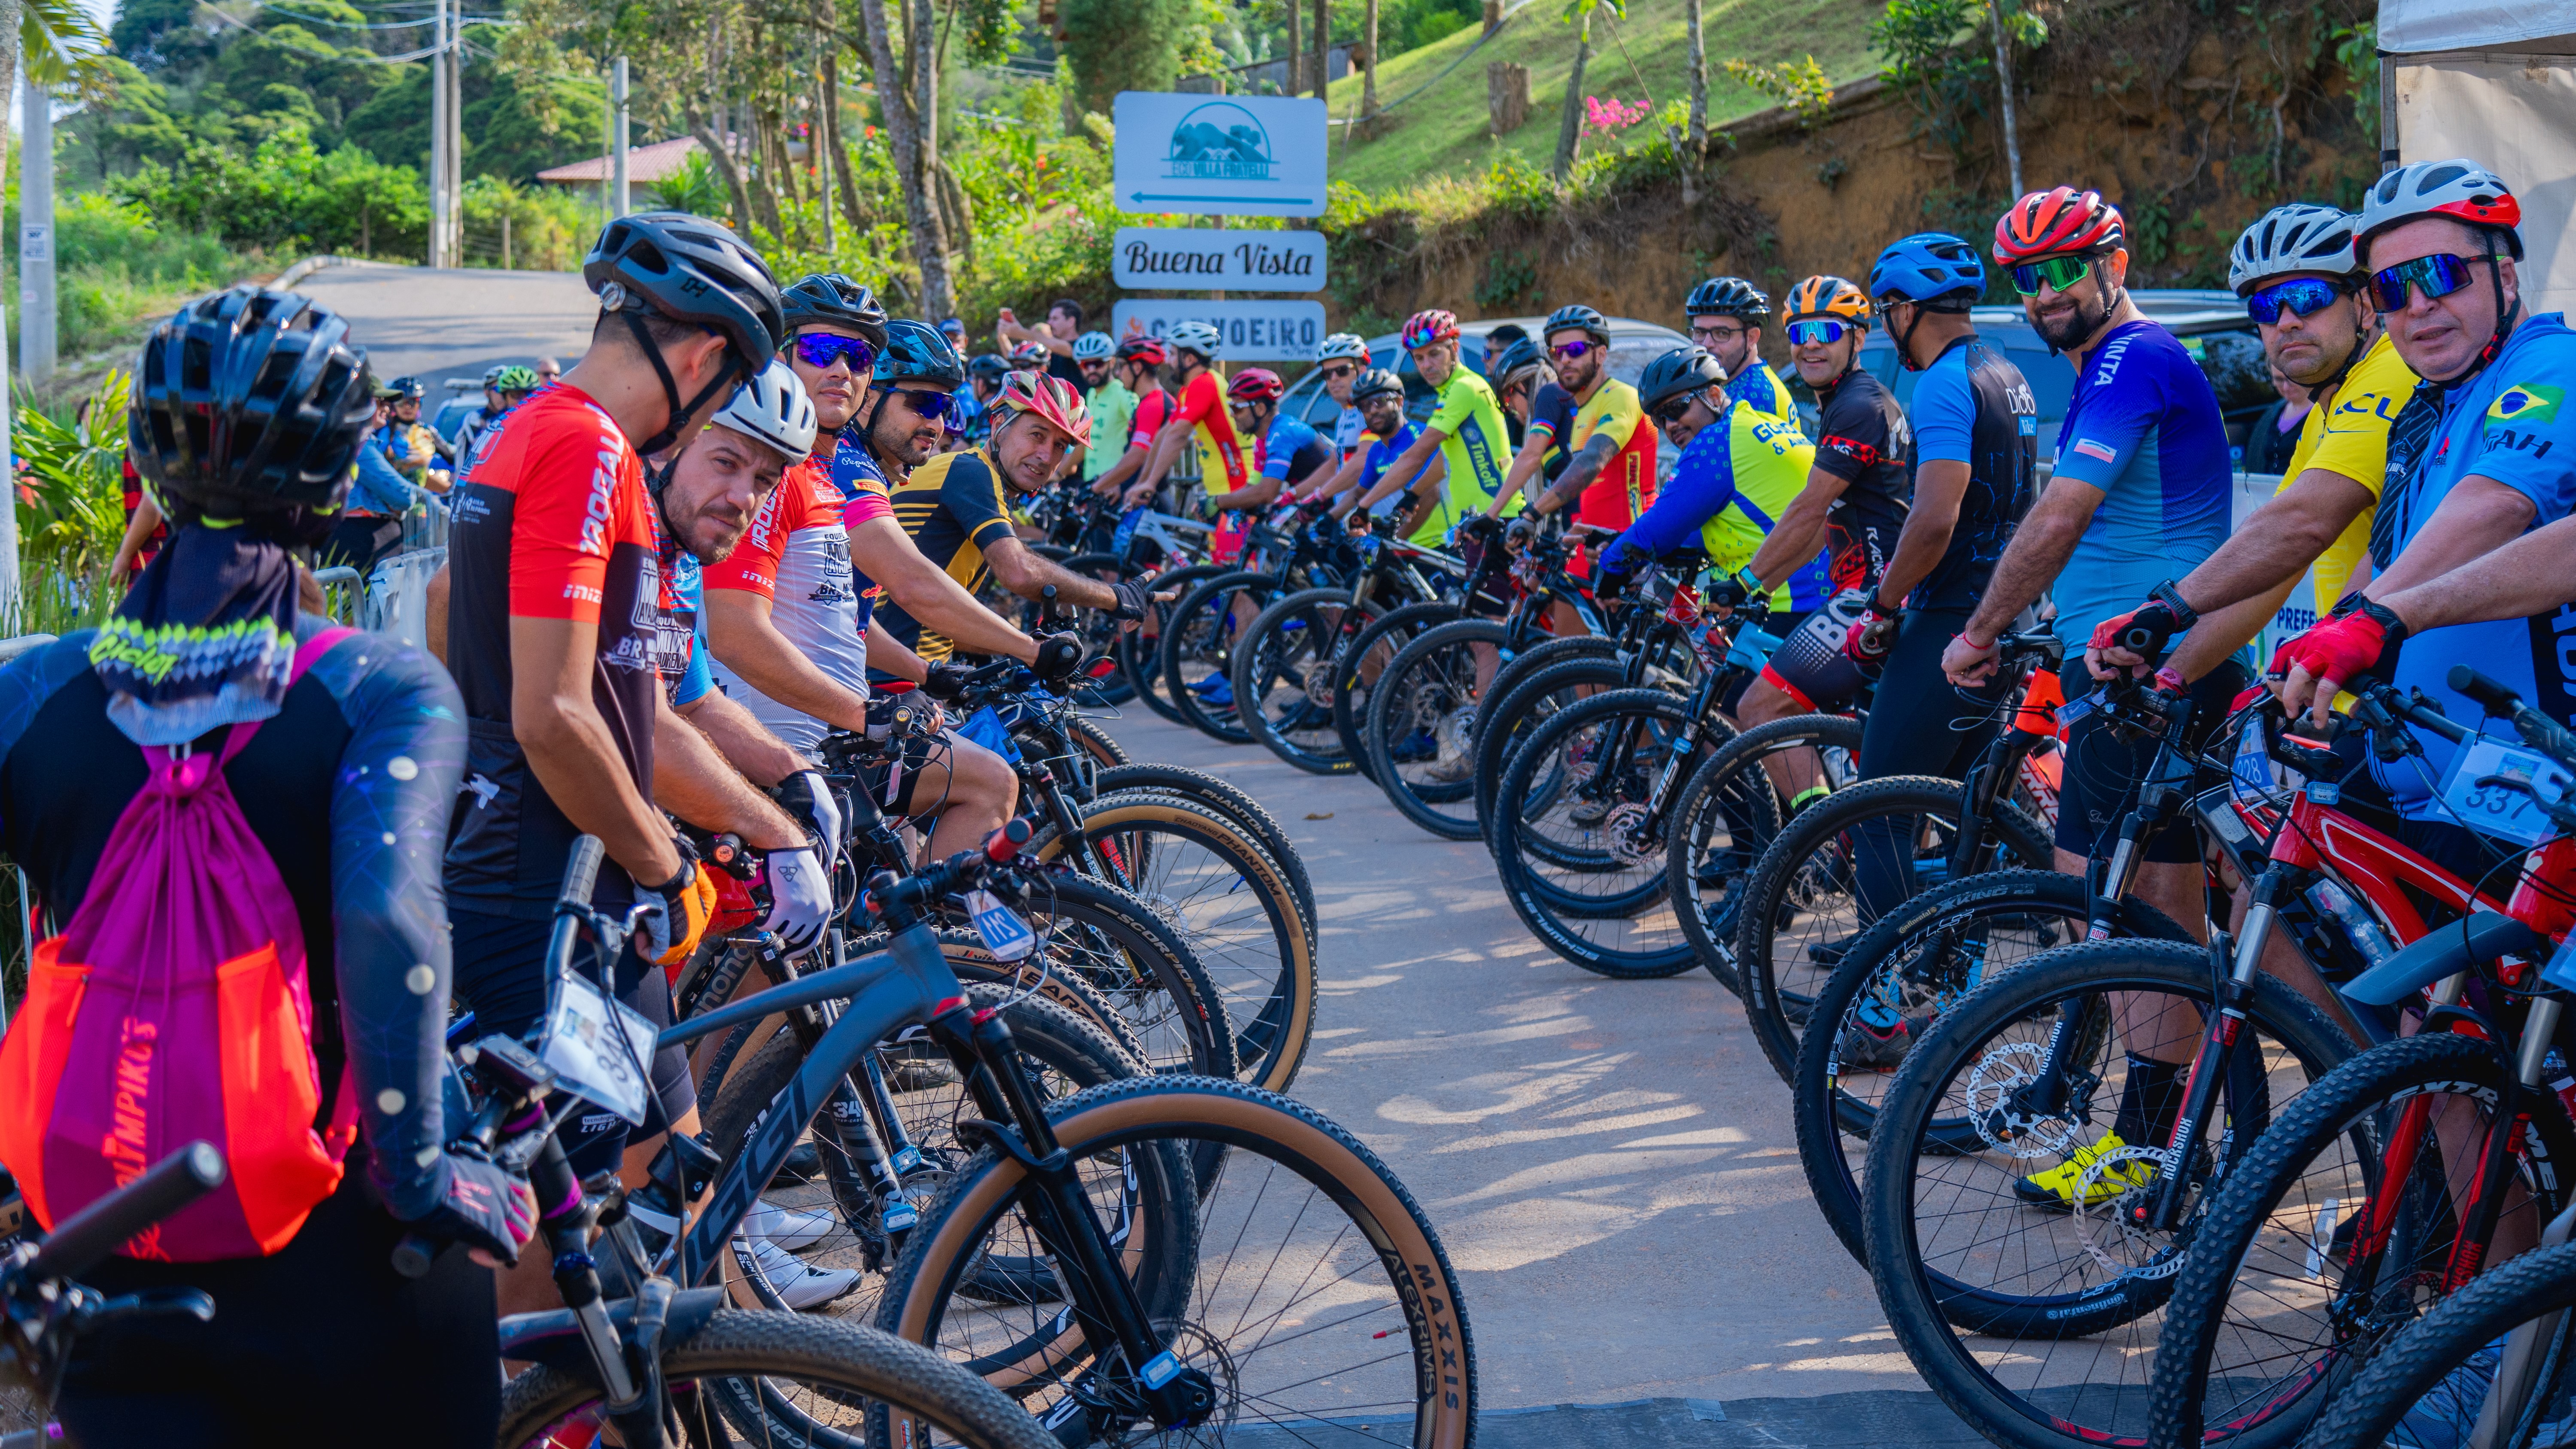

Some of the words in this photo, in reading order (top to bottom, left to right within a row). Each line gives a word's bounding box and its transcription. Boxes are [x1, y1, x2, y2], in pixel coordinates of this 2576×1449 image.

[1125, 240, 1224, 274] Buena
[1234, 243, 1312, 275] Vista
[1151, 317, 1315, 346] CVOEIRO
[2021, 419, 2034, 434] Bike
[1471, 441, 1498, 488] Tinkoff
[819, 583, 836, 595] BR
[2278, 607, 2315, 631] PREFE
[617, 636, 643, 659] BR
[2237, 756, 2262, 787] 228
[1200, 788, 1269, 838] PHANTOM
[1088, 861, 1102, 880] XCR
[1175, 816, 1218, 836] CHAOYANG
[1217, 833, 1281, 896] PHANTOM
[1520, 891, 1600, 961] SCHWALBE
[1899, 909, 1932, 933] Continental
[2091, 928, 2108, 941] ROCK
[1116, 914, 1199, 997] SCORPION
[582, 1115, 614, 1125] tecnologia
[832, 1102, 862, 1118] 34
[581, 1124, 614, 1133] LIGH
[2162, 1117, 2193, 1181] ROCKSHOX
[737, 1253, 744, 1268] SL
[743, 1254, 771, 1294] CONTROL
[1385, 1249, 1437, 1394] ALEXRIMS
[1414, 1264, 1458, 1411] MAXXIS
